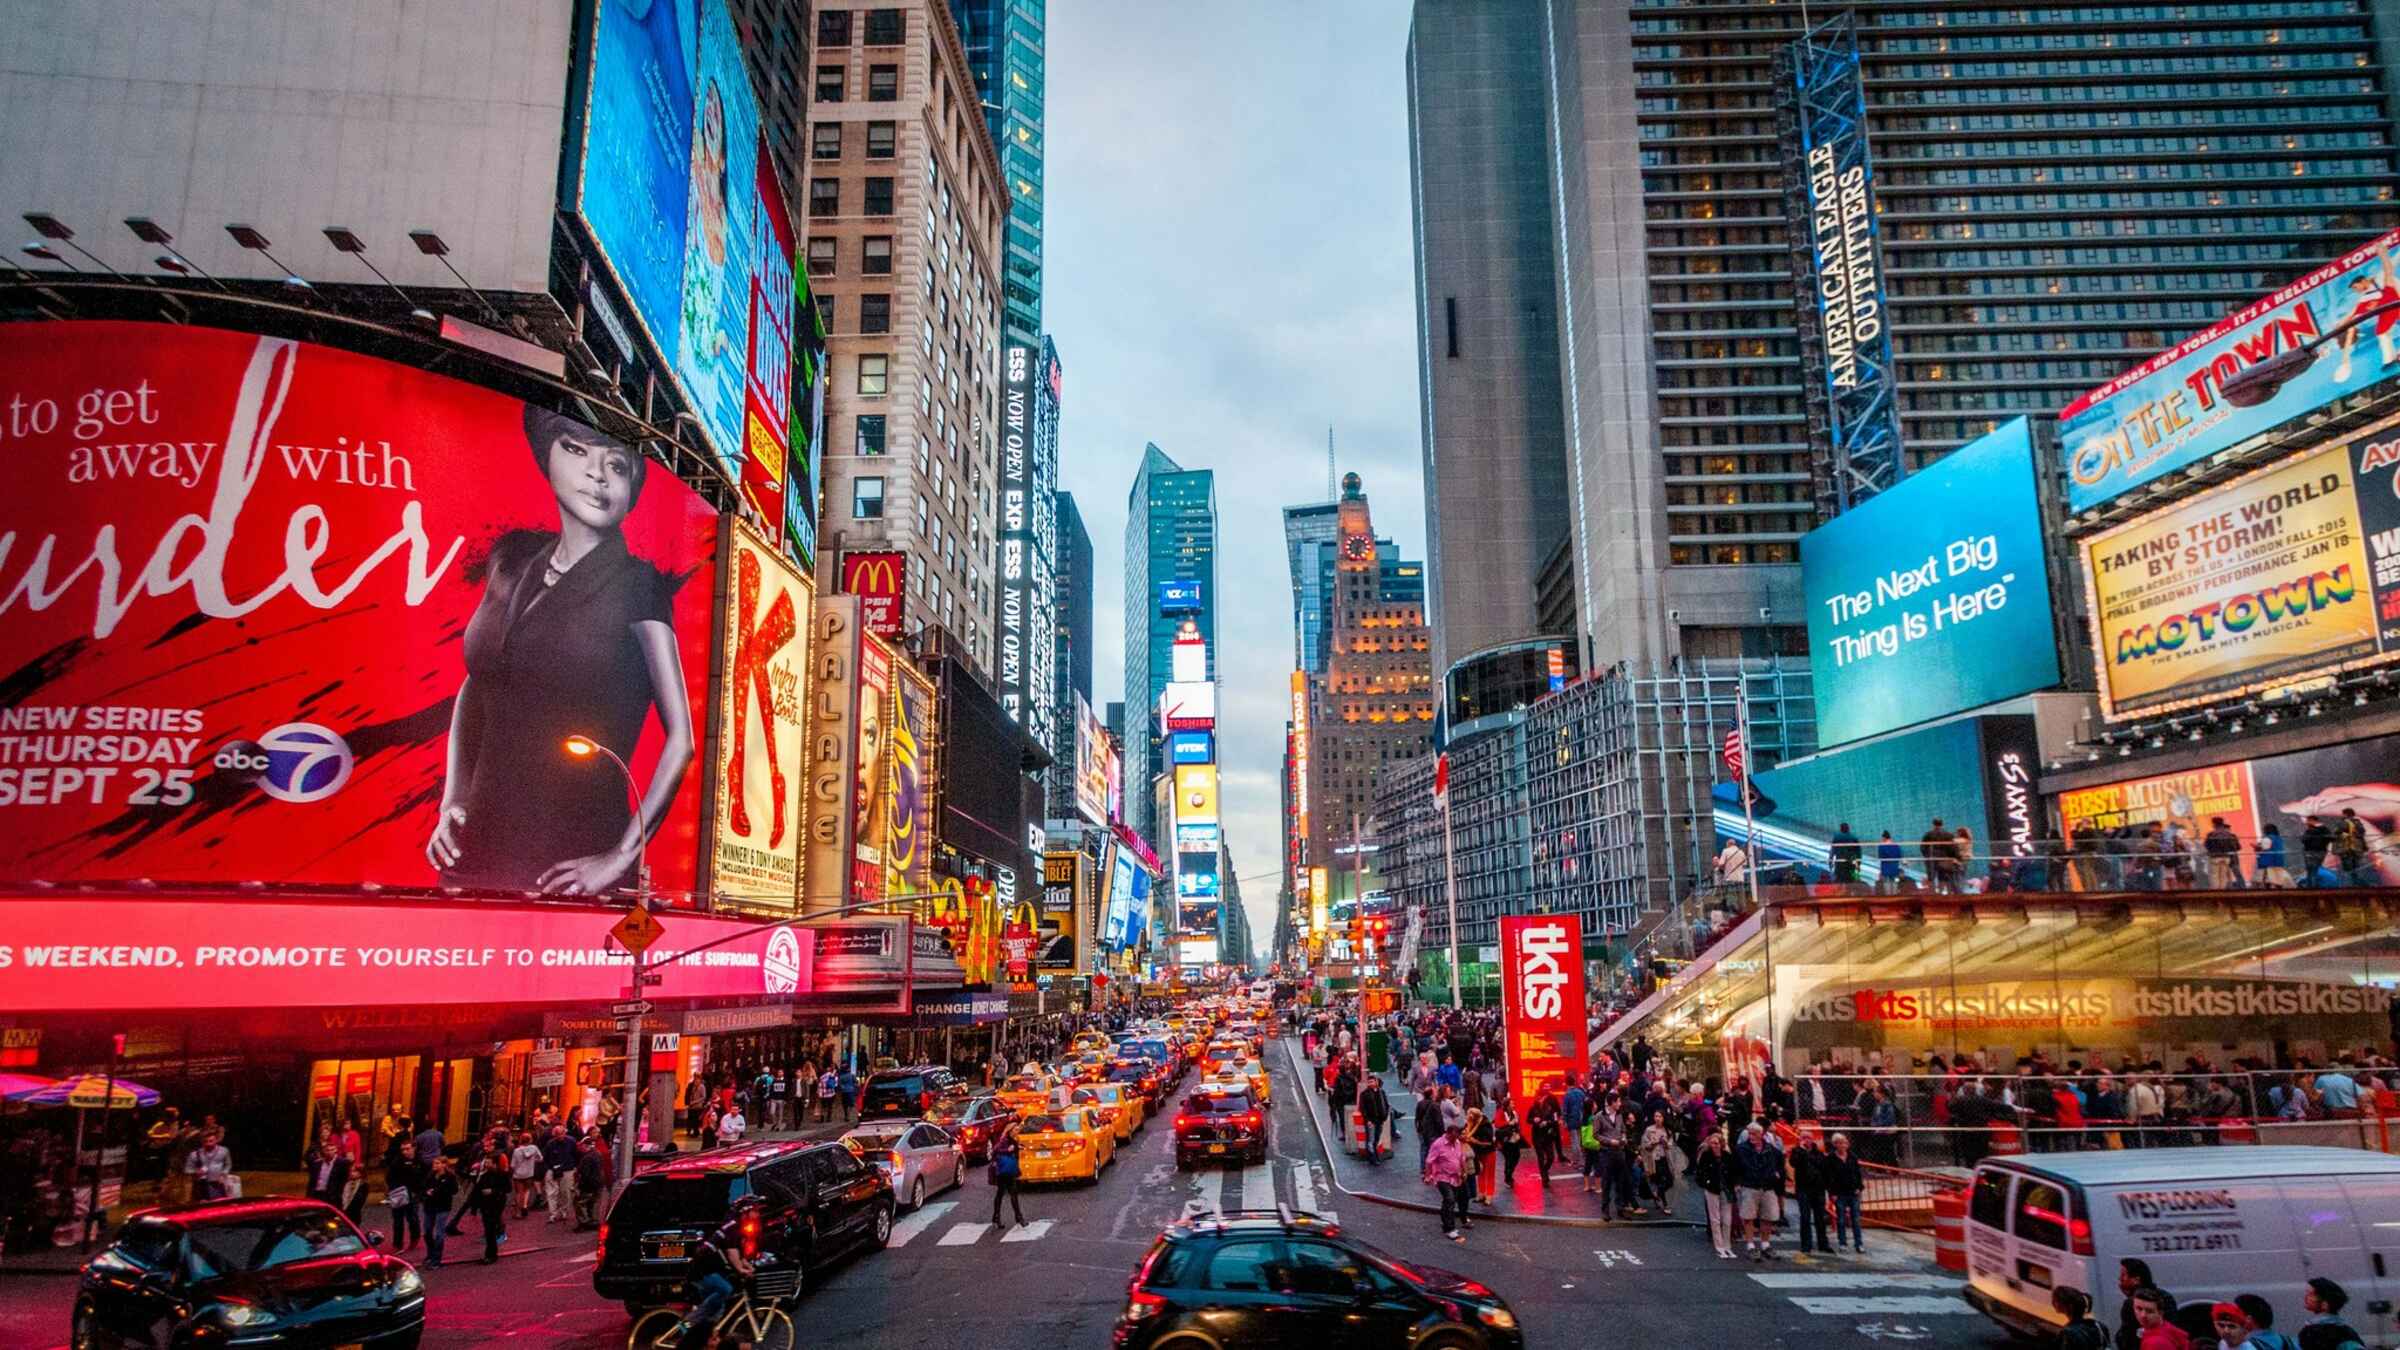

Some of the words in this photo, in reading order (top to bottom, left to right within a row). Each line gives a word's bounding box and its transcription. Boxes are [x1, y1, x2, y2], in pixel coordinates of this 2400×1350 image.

[1810, 141, 1839, 235] EAGLE
[1839, 165, 1881, 342] OUTFITTERS
[1818, 235, 1857, 388] AMERICAN
[2089, 381, 2114, 404] NEW
[2115, 367, 2150, 393] YORK,
[2153, 349, 2179, 370] NEW
[2182, 324, 2231, 354] YORK...
[2233, 308, 2258, 326] IT'S
[2261, 300, 2272, 313] A
[2274, 267, 2338, 305] HELLUVA
[1008, 348, 1025, 382] ESS
[11, 399, 58, 438] to
[73, 379, 159, 440] get
[1008, 388, 1024, 431] NOW
[2073, 424, 2134, 486] ON
[2127, 390, 2192, 449] THE
[2185, 301, 2322, 411] TOWN
[68, 440, 217, 488] away
[277, 437, 416, 491] with
[1006, 435, 1024, 482] OPEN
[2100, 531, 2181, 575] TAKING
[2186, 511, 2234, 543] THE
[2240, 473, 2341, 524] WORLD
[2147, 553, 2176, 578] BY
[2185, 517, 2284, 565] STORM!
[1826, 591, 1872, 625] The
[1876, 555, 1940, 607] Next
[1946, 535, 1998, 577] Big
[2105, 592, 2117, 606] ON
[2119, 584, 2144, 602] TOUR
[2146, 571, 2185, 593] ACROSS
[2187, 564, 2207, 580] THE
[2209, 558, 2225, 572] US
[2237, 539, 2283, 563] LONDON
[2286, 527, 2314, 546] FALL
[2318, 517, 2347, 534] 2015
[2107, 603, 2137, 621] FINAL
[2140, 584, 2200, 609] BROADWAY
[2204, 553, 2297, 591] PERFORMANCE
[2302, 542, 2330, 562] JAN
[2333, 534, 2350, 550] 18
[864, 596, 892, 606] PEN
[1004, 586, 1021, 634] NOW
[2116, 563, 2355, 664] MOTOWN
[872, 623, 897, 633] URS
[1830, 623, 1898, 668] Thing
[1903, 612, 1928, 642] Is
[2151, 654, 2173, 667] THE
[2176, 642, 2216, 660] SMASH
[2220, 634, 2249, 651] HITS
[2252, 617, 2312, 640] MUSICAL
[1003, 636, 1020, 686] OPEN
[1, 706, 78, 730] NEW
[85, 708, 204, 732] SERIES
[812, 611, 846, 845] PALACE
[1168, 719, 1214, 729] TOSHIBA
[0, 735, 200, 765] THURSDAY
[214, 749, 270, 770] abc
[0, 768, 119, 805] SEPT
[128, 769, 195, 806] 25
[2066, 786, 2121, 818] BEST
[2125, 767, 2241, 810] MUSICAL!
[2192, 795, 2242, 816] WINNER
[2005, 783, 2034, 857] GALAXY
[721, 861, 750, 876] INCLUDING
[751, 867, 767, 878] BEST
[768, 871, 793, 885] MUSICAL
[24, 946, 185, 968] WEEKEND.
[195, 946, 346, 967] PROMOTE
[357, 947, 496, 967] YOURSELF
[504, 949, 534, 966] TO
[677, 950, 702, 966] THE
[704, 950, 760, 967] SURFBOARD.
[1522, 923, 1570, 1021] tkts
[321, 1004, 433, 1028] WELLS
[916, 1003, 971, 1015] CHANGE
[2157, 1189, 2237, 1211] FLOORING
